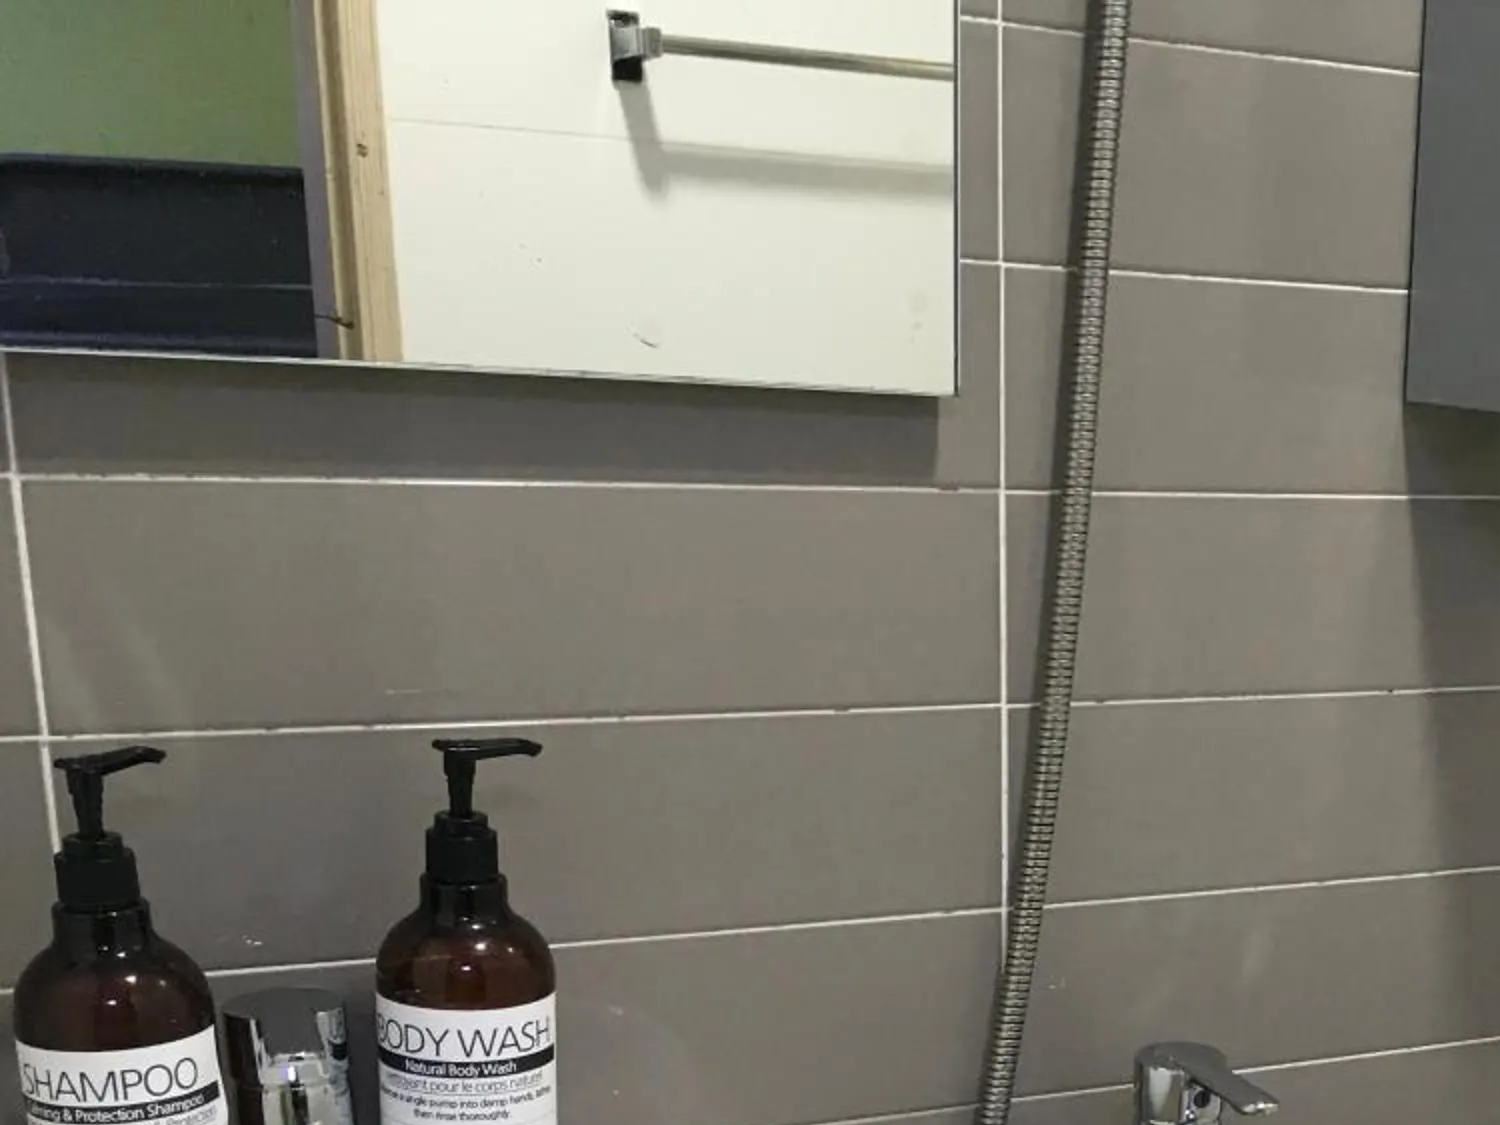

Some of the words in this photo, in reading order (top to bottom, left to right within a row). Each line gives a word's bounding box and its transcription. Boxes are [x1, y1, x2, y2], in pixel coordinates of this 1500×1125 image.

[376, 1013, 450, 1057] BODY
[457, 1015, 551, 1058] WASH
[22, 1057, 199, 1103] SHAMPOO
[404, 1059, 446, 1075] Natural
[448, 1063, 479, 1078] Body
[480, 1061, 517, 1075] Wash
[429, 1080, 459, 1095] pour
[475, 1079, 508, 1095] corps
[63, 1108, 73, 1121] &
[75, 1107, 145, 1123] Protection
[146, 1094, 205, 1117] Shampoo
